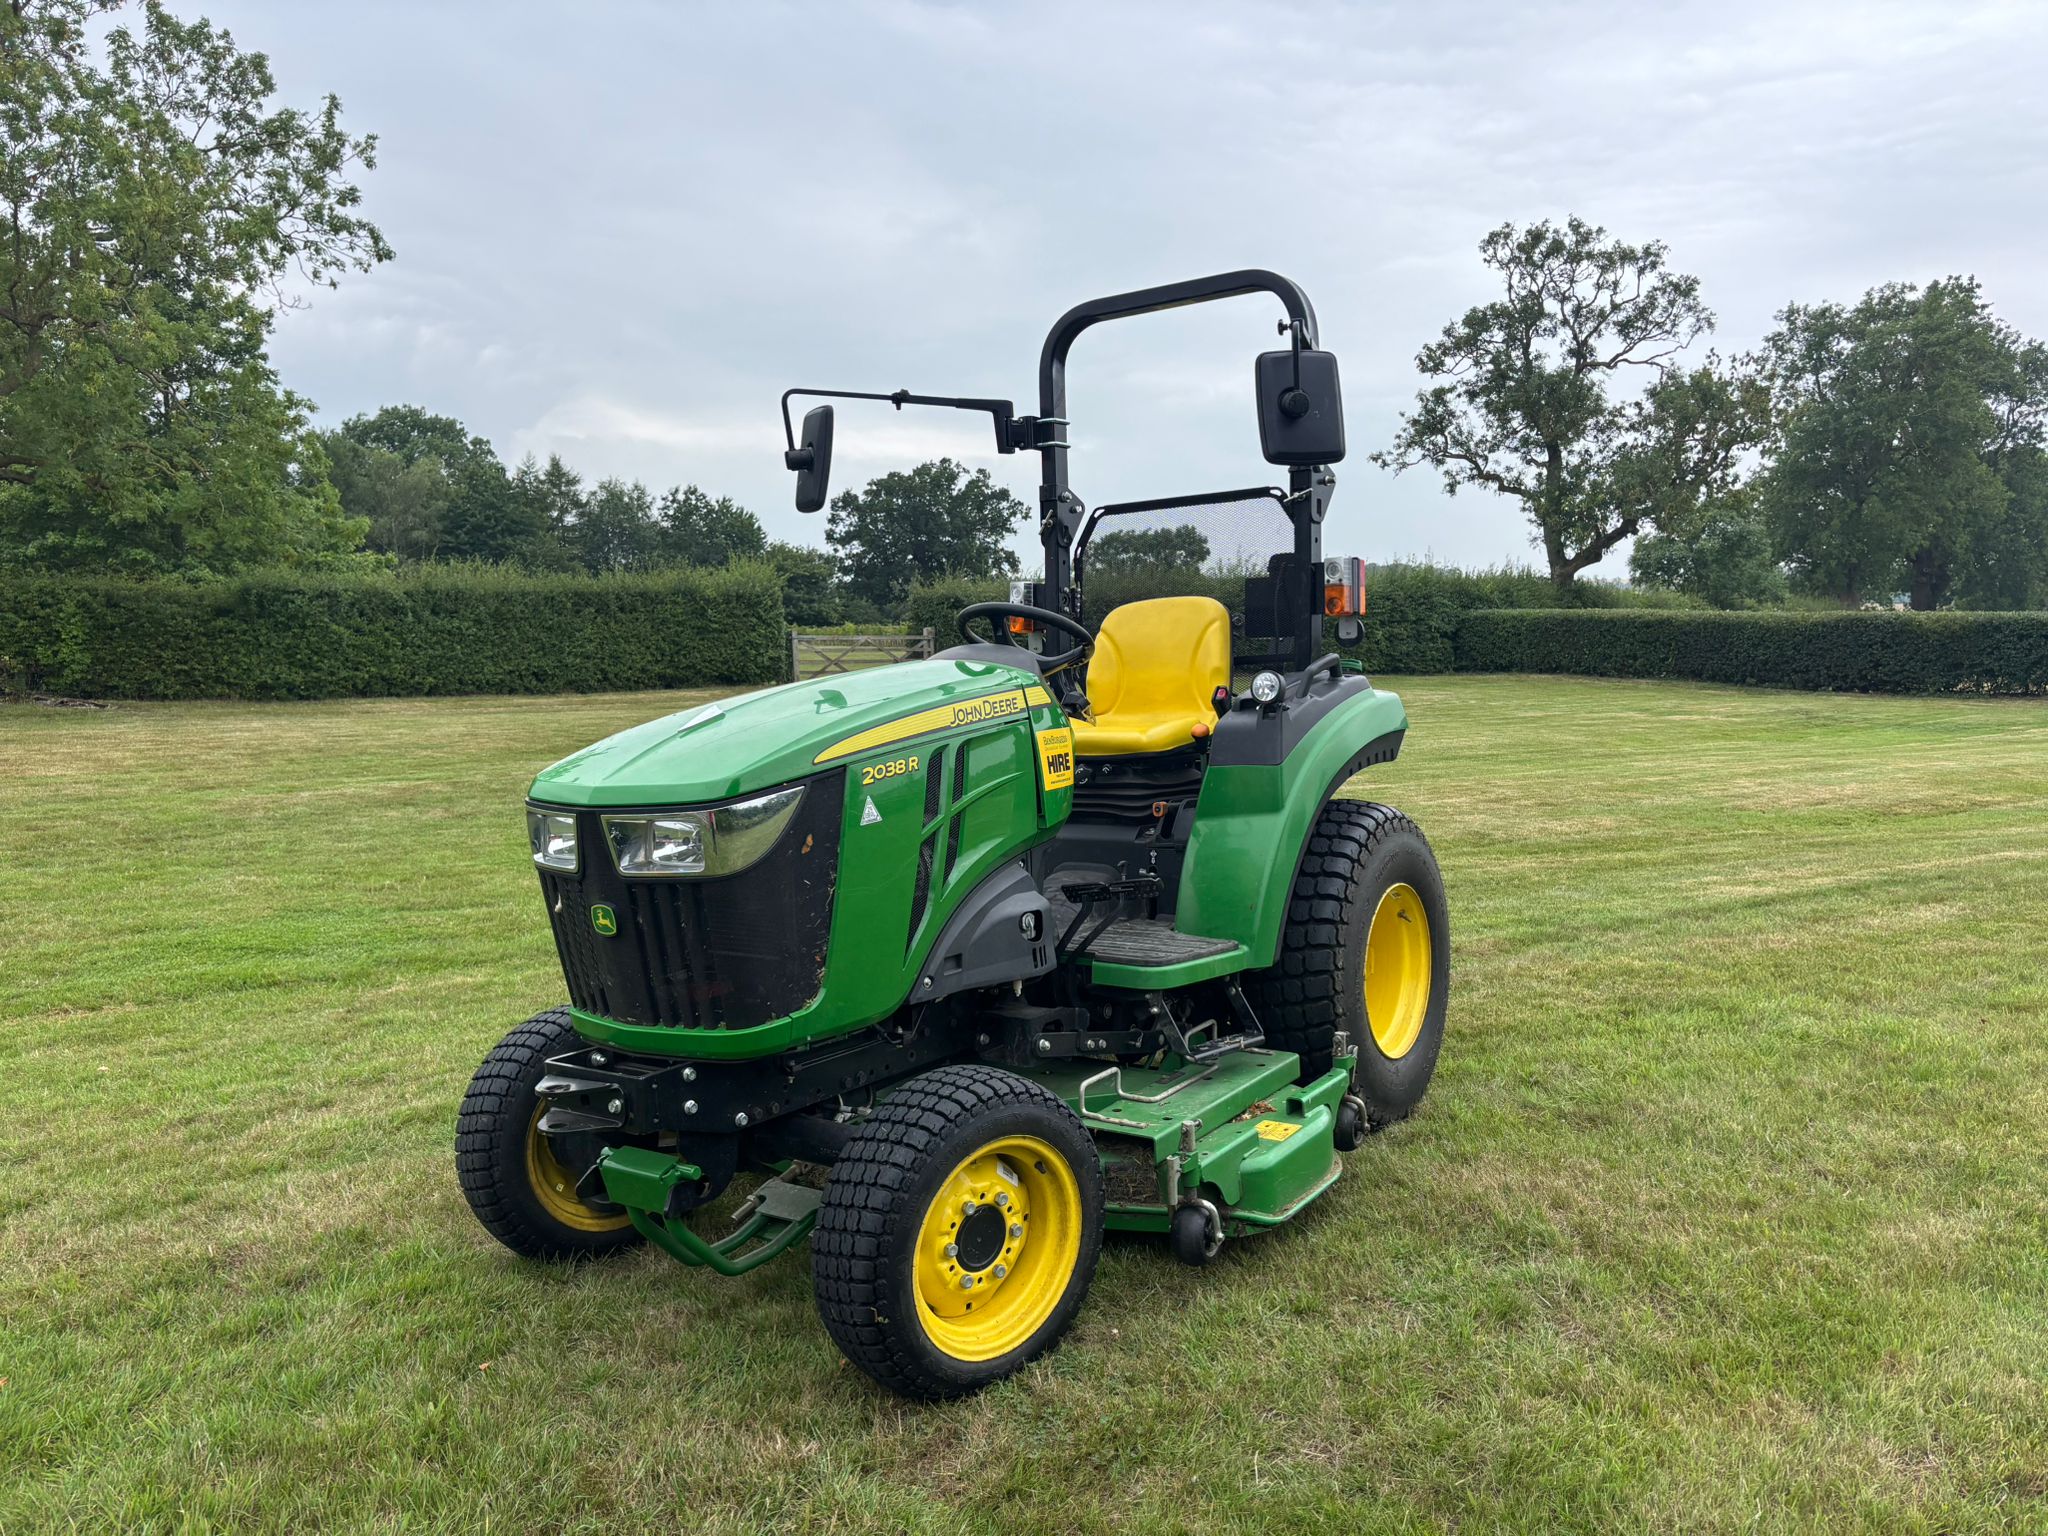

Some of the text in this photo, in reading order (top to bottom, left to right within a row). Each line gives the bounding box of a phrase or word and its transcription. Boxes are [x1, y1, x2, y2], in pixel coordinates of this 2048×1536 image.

[950, 697, 1019, 725] JOHN DEERE
[1046, 752, 1071, 774] HIRE
